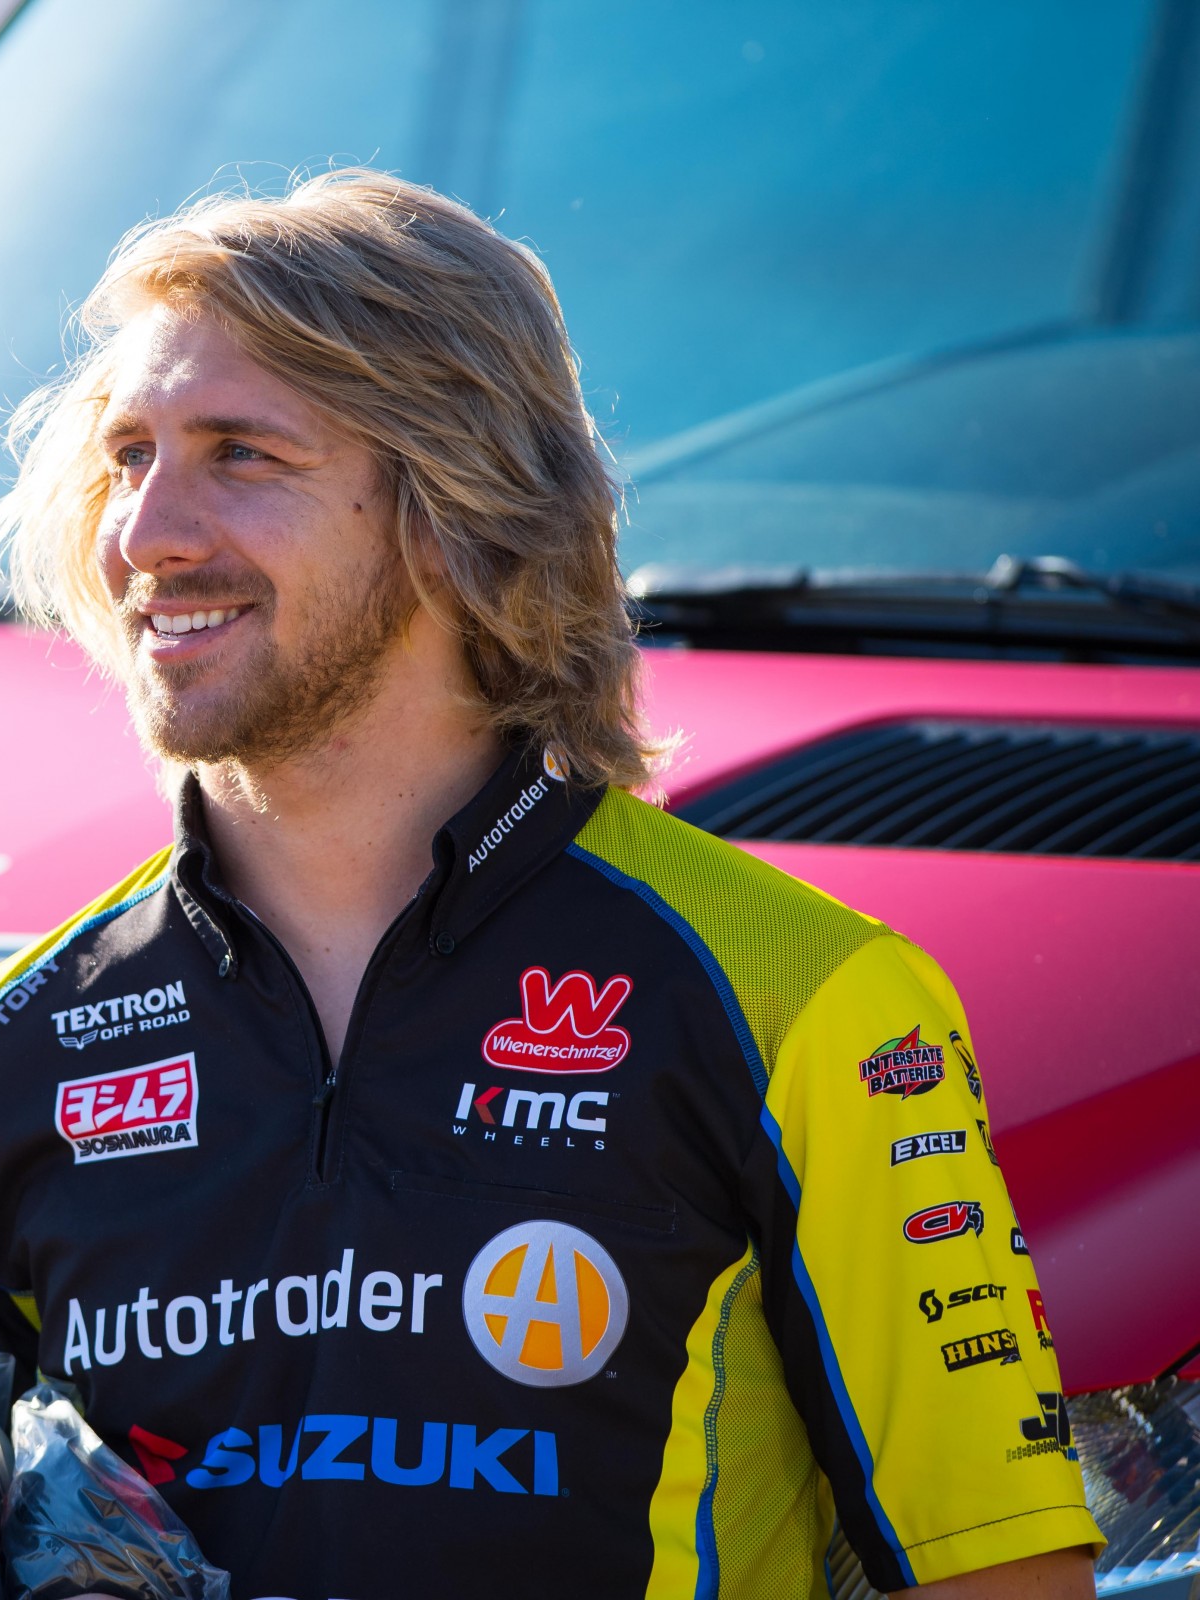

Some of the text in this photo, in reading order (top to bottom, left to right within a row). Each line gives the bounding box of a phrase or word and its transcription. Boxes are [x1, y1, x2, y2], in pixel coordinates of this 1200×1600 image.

[467, 776, 549, 873] Autotrader
[51, 980, 187, 1035] TEXTRON
[100, 1009, 191, 1041] OFF ROAD
[491, 1035, 623, 1061] Wienerschnitzel
[861, 1047, 944, 1079] INTERSTATE
[870, 1064, 944, 1094] BATTERIES
[65, 1066, 188, 1137] ヨシムラ
[74, 1122, 192, 1158] YOSHIMURA
[452, 1125, 606, 1150] WHEELS
[894, 1132, 963, 1163] EXCEL
[64, 1248, 443, 1376] Autotrader
[943, 1330, 1018, 1366] HINS
[186, 1414, 560, 1497] SUZUKI
